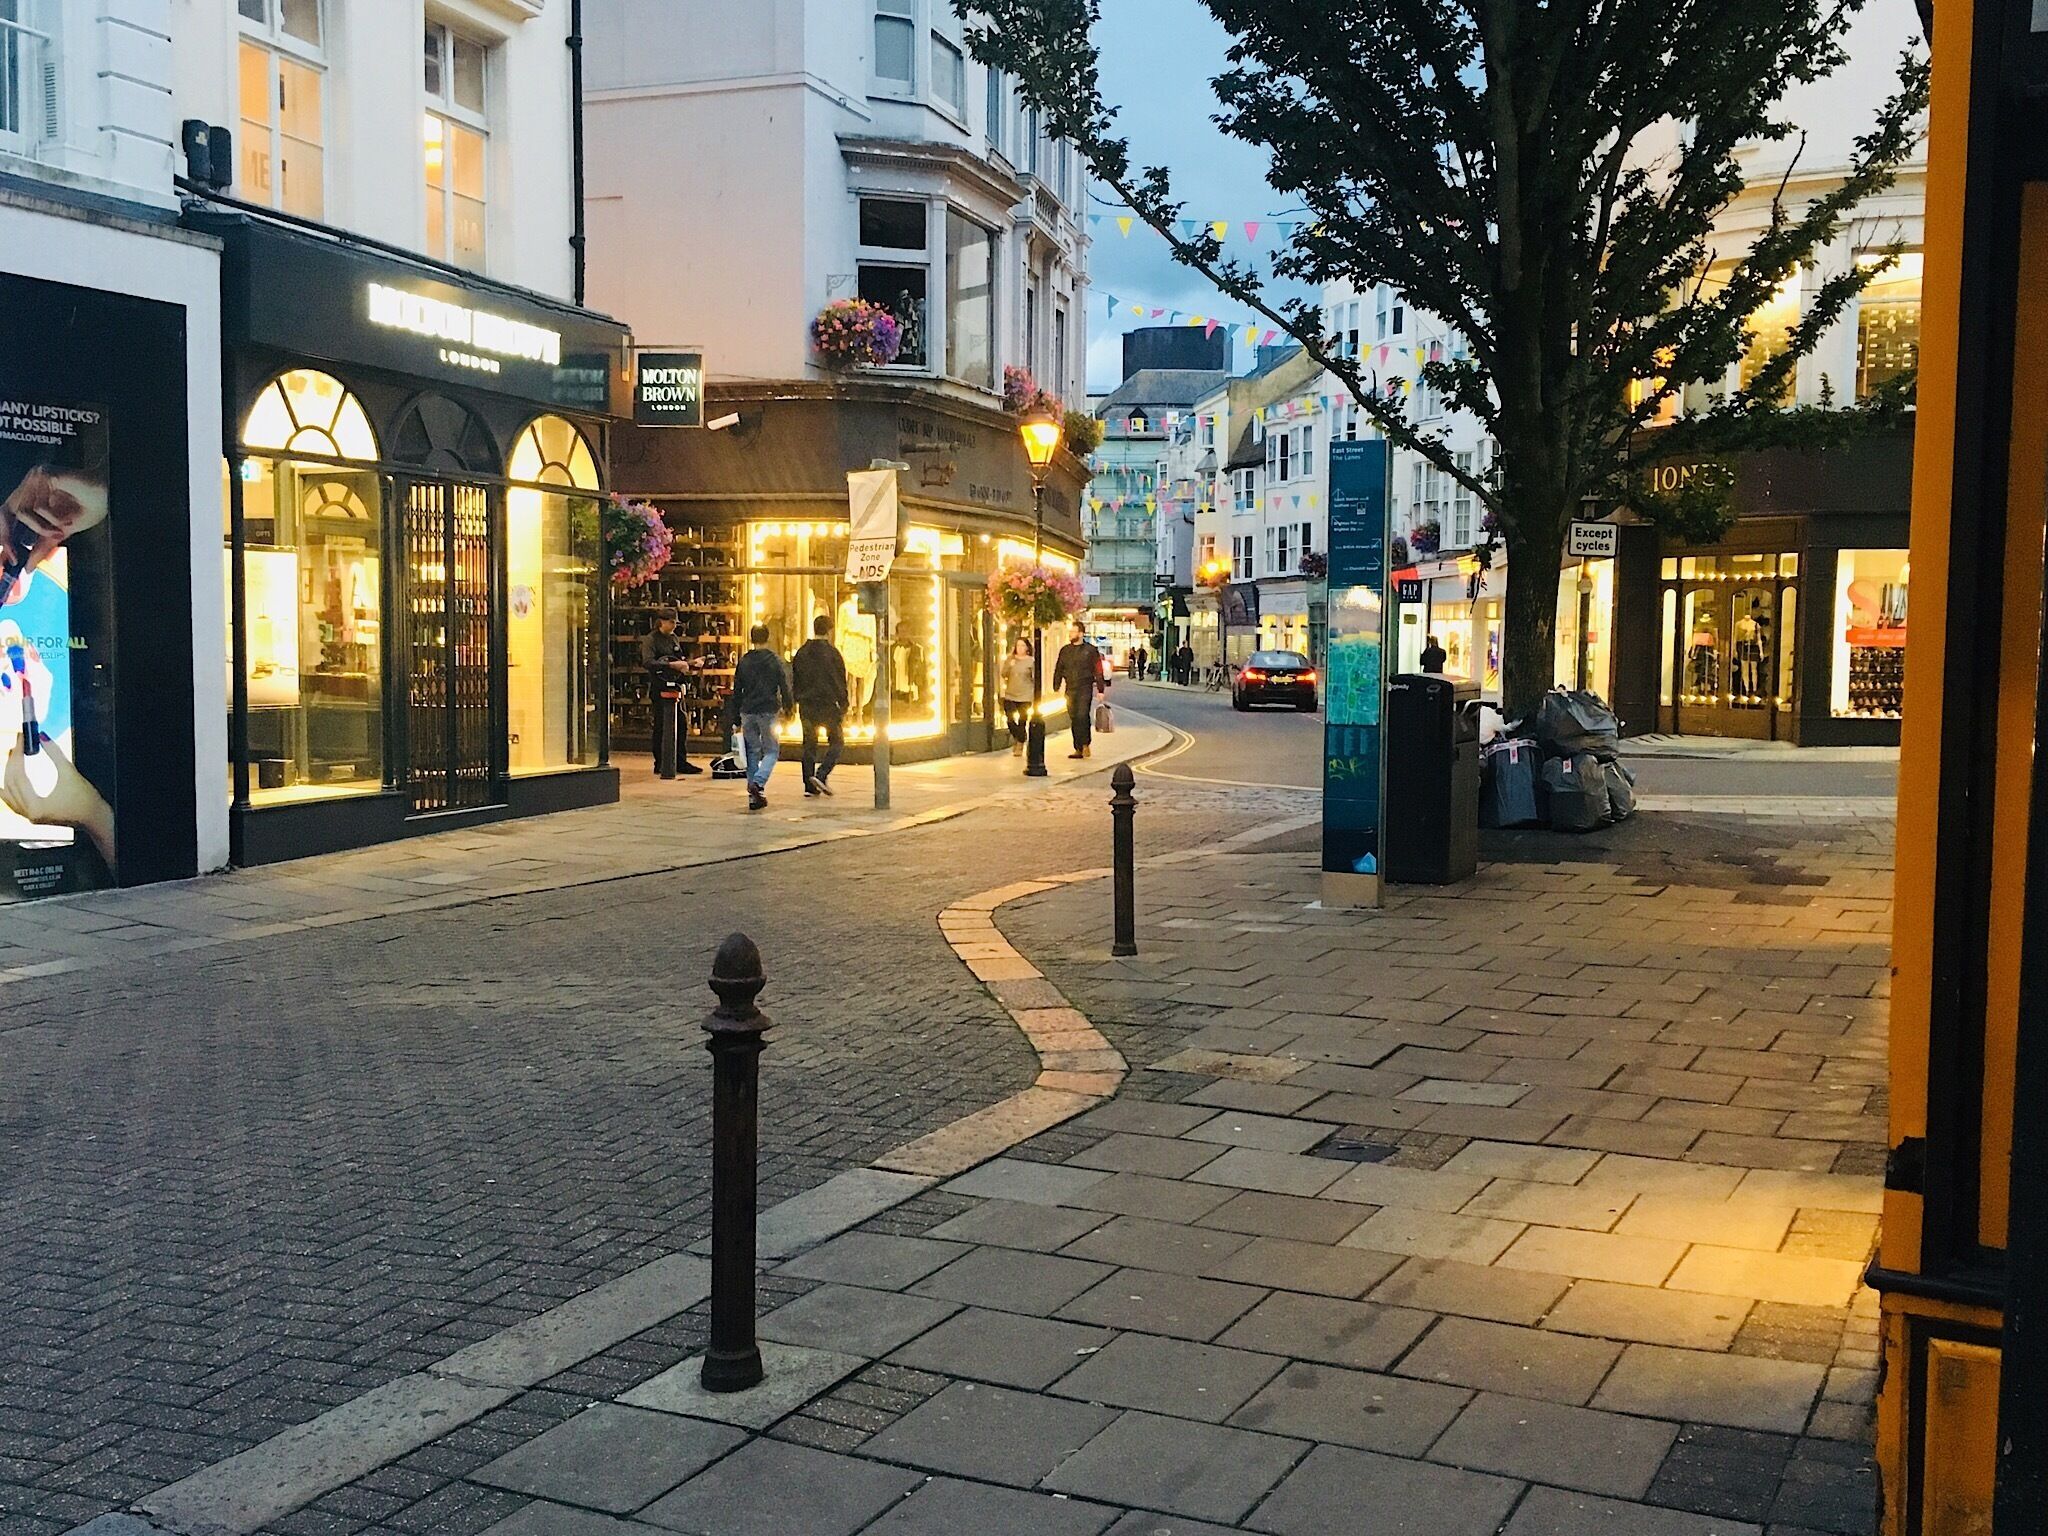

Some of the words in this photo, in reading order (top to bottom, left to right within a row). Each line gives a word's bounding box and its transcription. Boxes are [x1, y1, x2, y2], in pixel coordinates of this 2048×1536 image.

[642, 368, 697, 384] MOLTON
[642, 386, 696, 401] BROWN
[0, 400, 30, 415] ANY
[32, 404, 100, 424] LIPSTICKS?
[13, 416, 77, 436] POSSIBLE.
[1575, 527, 1613, 539] Except
[849, 543, 895, 553] Pedestrian
[1576, 542, 1610, 551] cycles
[860, 553, 881, 562] Zone
[1402, 583, 1418, 596] GAP
[37, 636, 63, 649] FOR
[66, 636, 88, 649] ALL
